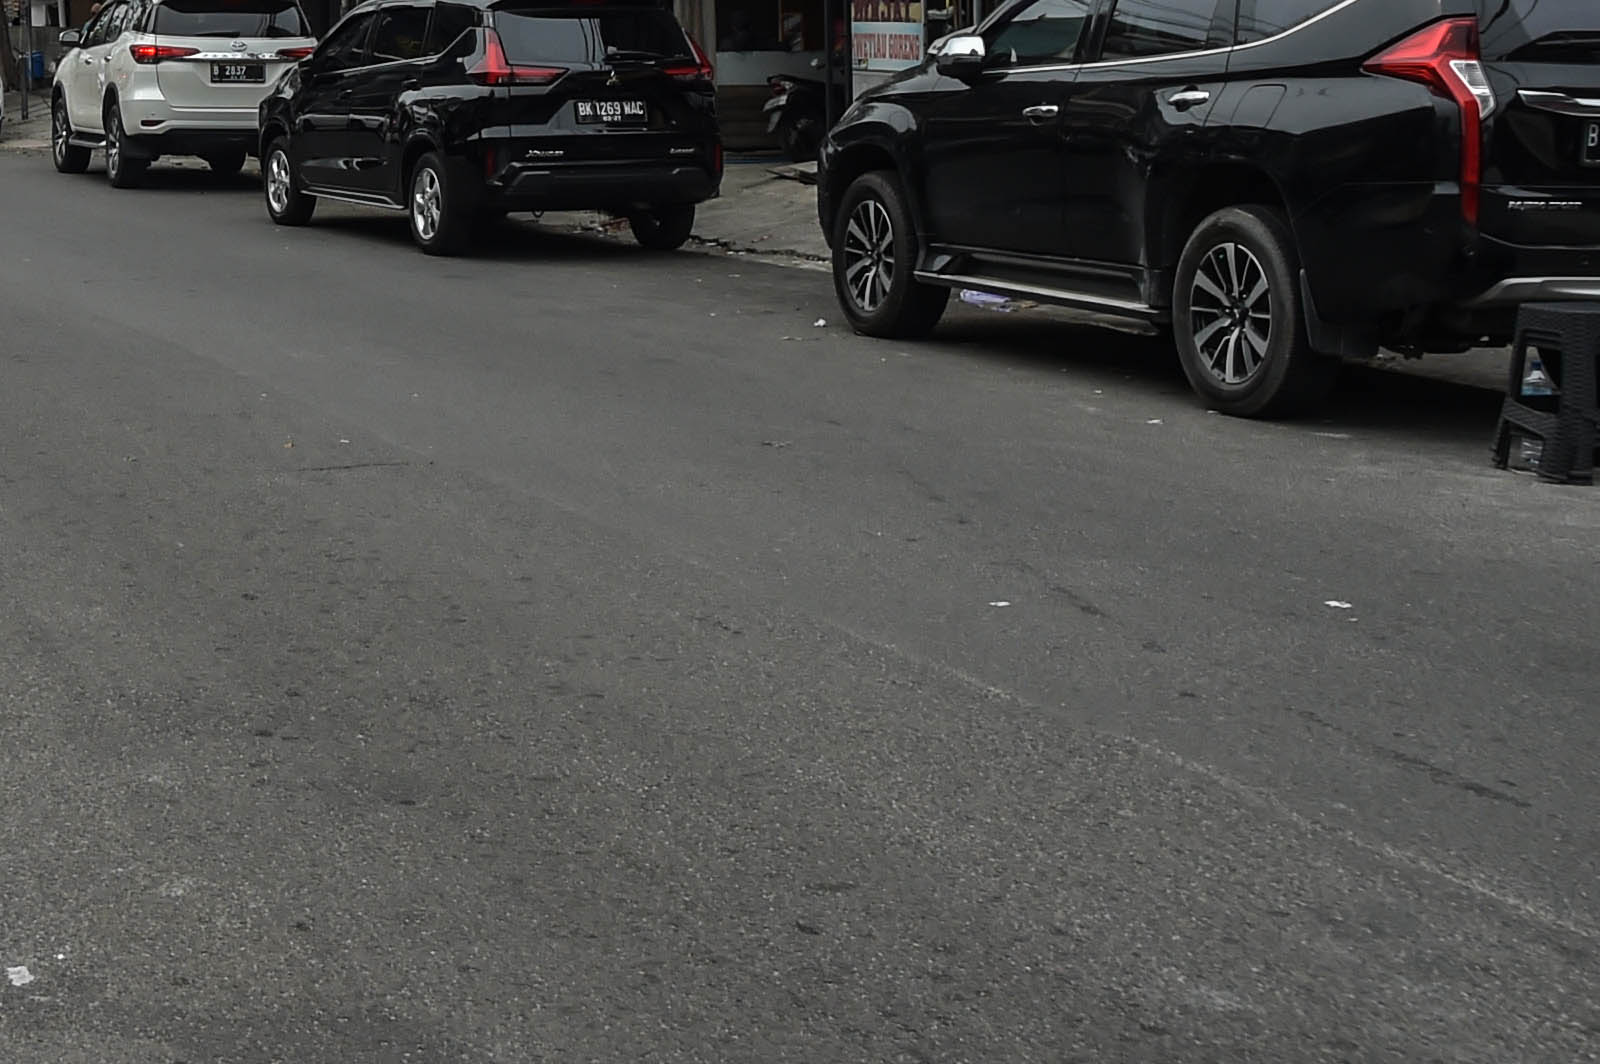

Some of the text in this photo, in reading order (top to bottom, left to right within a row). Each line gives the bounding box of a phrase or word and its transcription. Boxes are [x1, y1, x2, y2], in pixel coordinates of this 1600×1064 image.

[578, 100, 644, 116] BK 1269 WAC
